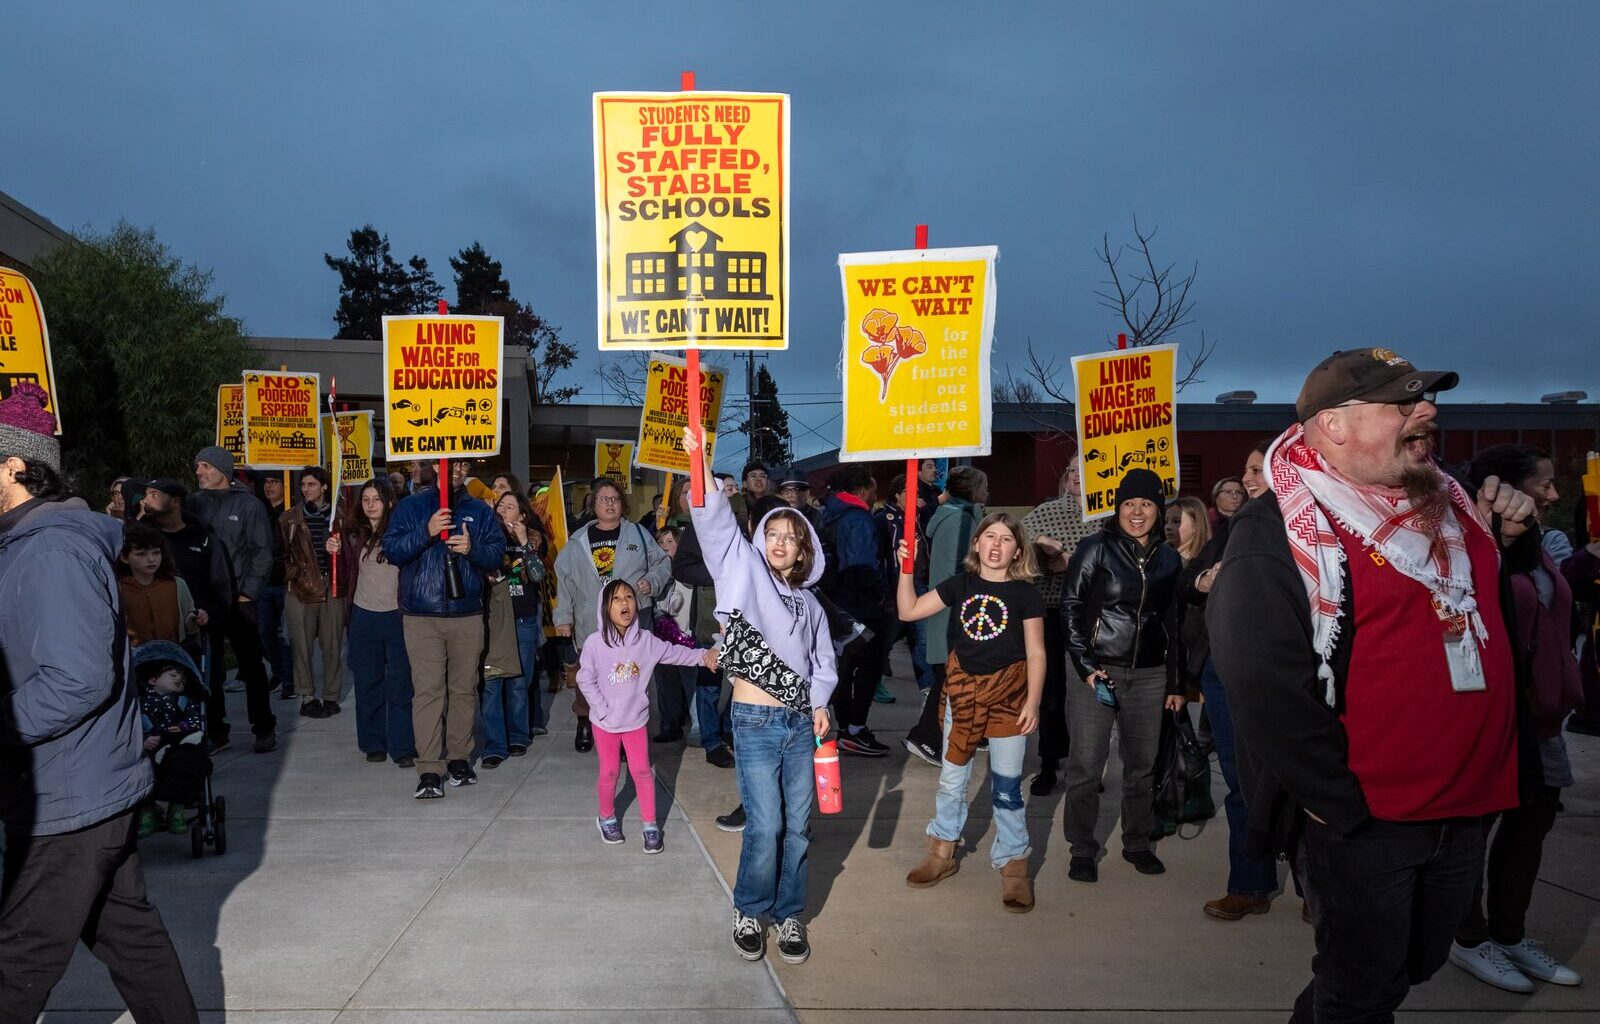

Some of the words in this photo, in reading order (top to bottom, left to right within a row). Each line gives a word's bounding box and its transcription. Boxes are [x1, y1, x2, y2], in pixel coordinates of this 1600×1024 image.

[639, 105, 709, 125] STUDENTS
[715, 106, 750, 123] NEED
[642, 125, 746, 148] FULLY
[616, 149, 770, 174] STAFFED,
[627, 174, 751, 197] STABLE
[618, 197, 771, 221] SCHOOLS
[858, 278, 896, 297] WE
[902, 275, 974, 295] CAN'T
[911, 298, 973, 316] WAIT
[621, 310, 650, 334] WE
[656, 308, 709, 333] CAN'T
[716, 307, 769, 333] WAIT!
[416, 323, 476, 345] LIVING
[944, 328, 969, 341] for
[401, 346, 455, 367] WAGE
[457, 352, 479, 367] FOR
[940, 345, 968, 360] the
[394, 368, 497, 390] EDUCATORS
[912, 366, 967, 380] future
[1100, 355, 1151, 386] LIVING
[264, 376, 300, 389] NO
[660, 379, 715, 403] PODEOS
[937, 382, 967, 396] our
[258, 388, 311, 403] PODEMOS
[1089, 383, 1134, 412] WAGE
[1136, 386, 1156, 404] FOR
[261, 403, 308, 417] ESPERAR
[661, 396, 710, 418] ESPER
[889, 400, 967, 417] students
[894, 420, 968, 435] deserve
[1084, 402, 1172, 440] EDUCATORS
[391, 437, 414, 452] WE
[418, 436, 457, 451] CAN'T
[461, 435, 494, 450] WAIT
[342, 469, 369, 480] CHOOLS
[346, 459, 367, 469] STAFF
[1086, 492, 1103, 512] WE
[1162, 478, 1175, 496] IT
